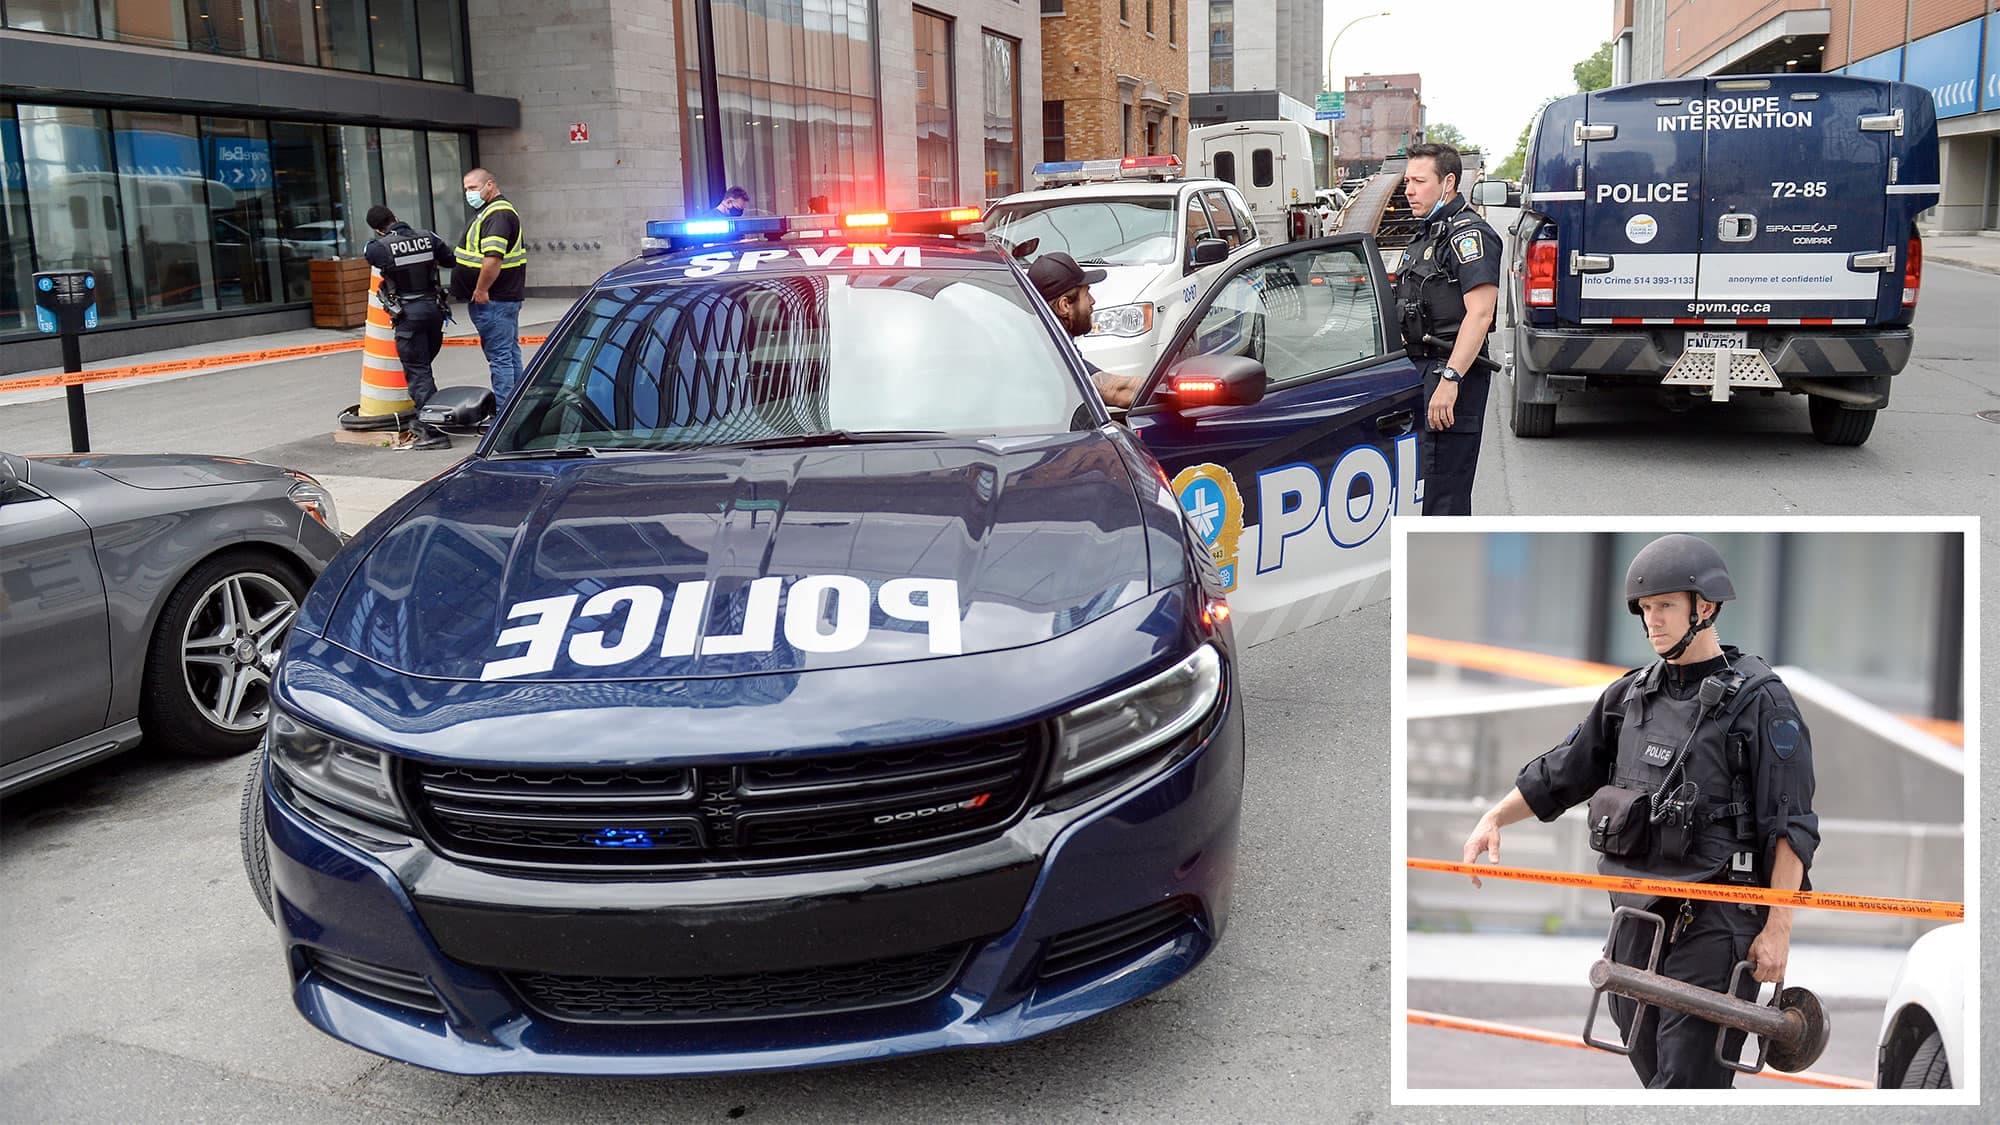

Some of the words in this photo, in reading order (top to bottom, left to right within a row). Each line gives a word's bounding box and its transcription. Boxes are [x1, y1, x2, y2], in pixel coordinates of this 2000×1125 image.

[1687, 97, 1780, 115] GROUPE
[1656, 111, 1813, 132] INTERVENTION
[1597, 182, 1689, 203] POLICE
[1771, 182, 1827, 198] 72-85
[390, 237, 432, 255] POLICE
[1792, 237, 1833, 245] COMPAK
[683, 246, 922, 278] SPVM
[1584, 276, 1602, 285] Info
[1604, 276, 1632, 285] Crime
[1634, 276, 1650, 285] 514
[1652, 276, 1695, 285] 393-1133
[1728, 276, 1767, 284] anonyme
[1770, 275, 1779, 283] et
[1781, 275, 1833, 283] confidentiel
[1687, 303, 1771, 315] spvm.qc.ca
[1644, 745, 1672, 761] POLICE
[873, 799, 978, 824] DODGE
[1733, 891, 1765, 900] POLICE
[1901, 905, 1933, 914] POLICE
